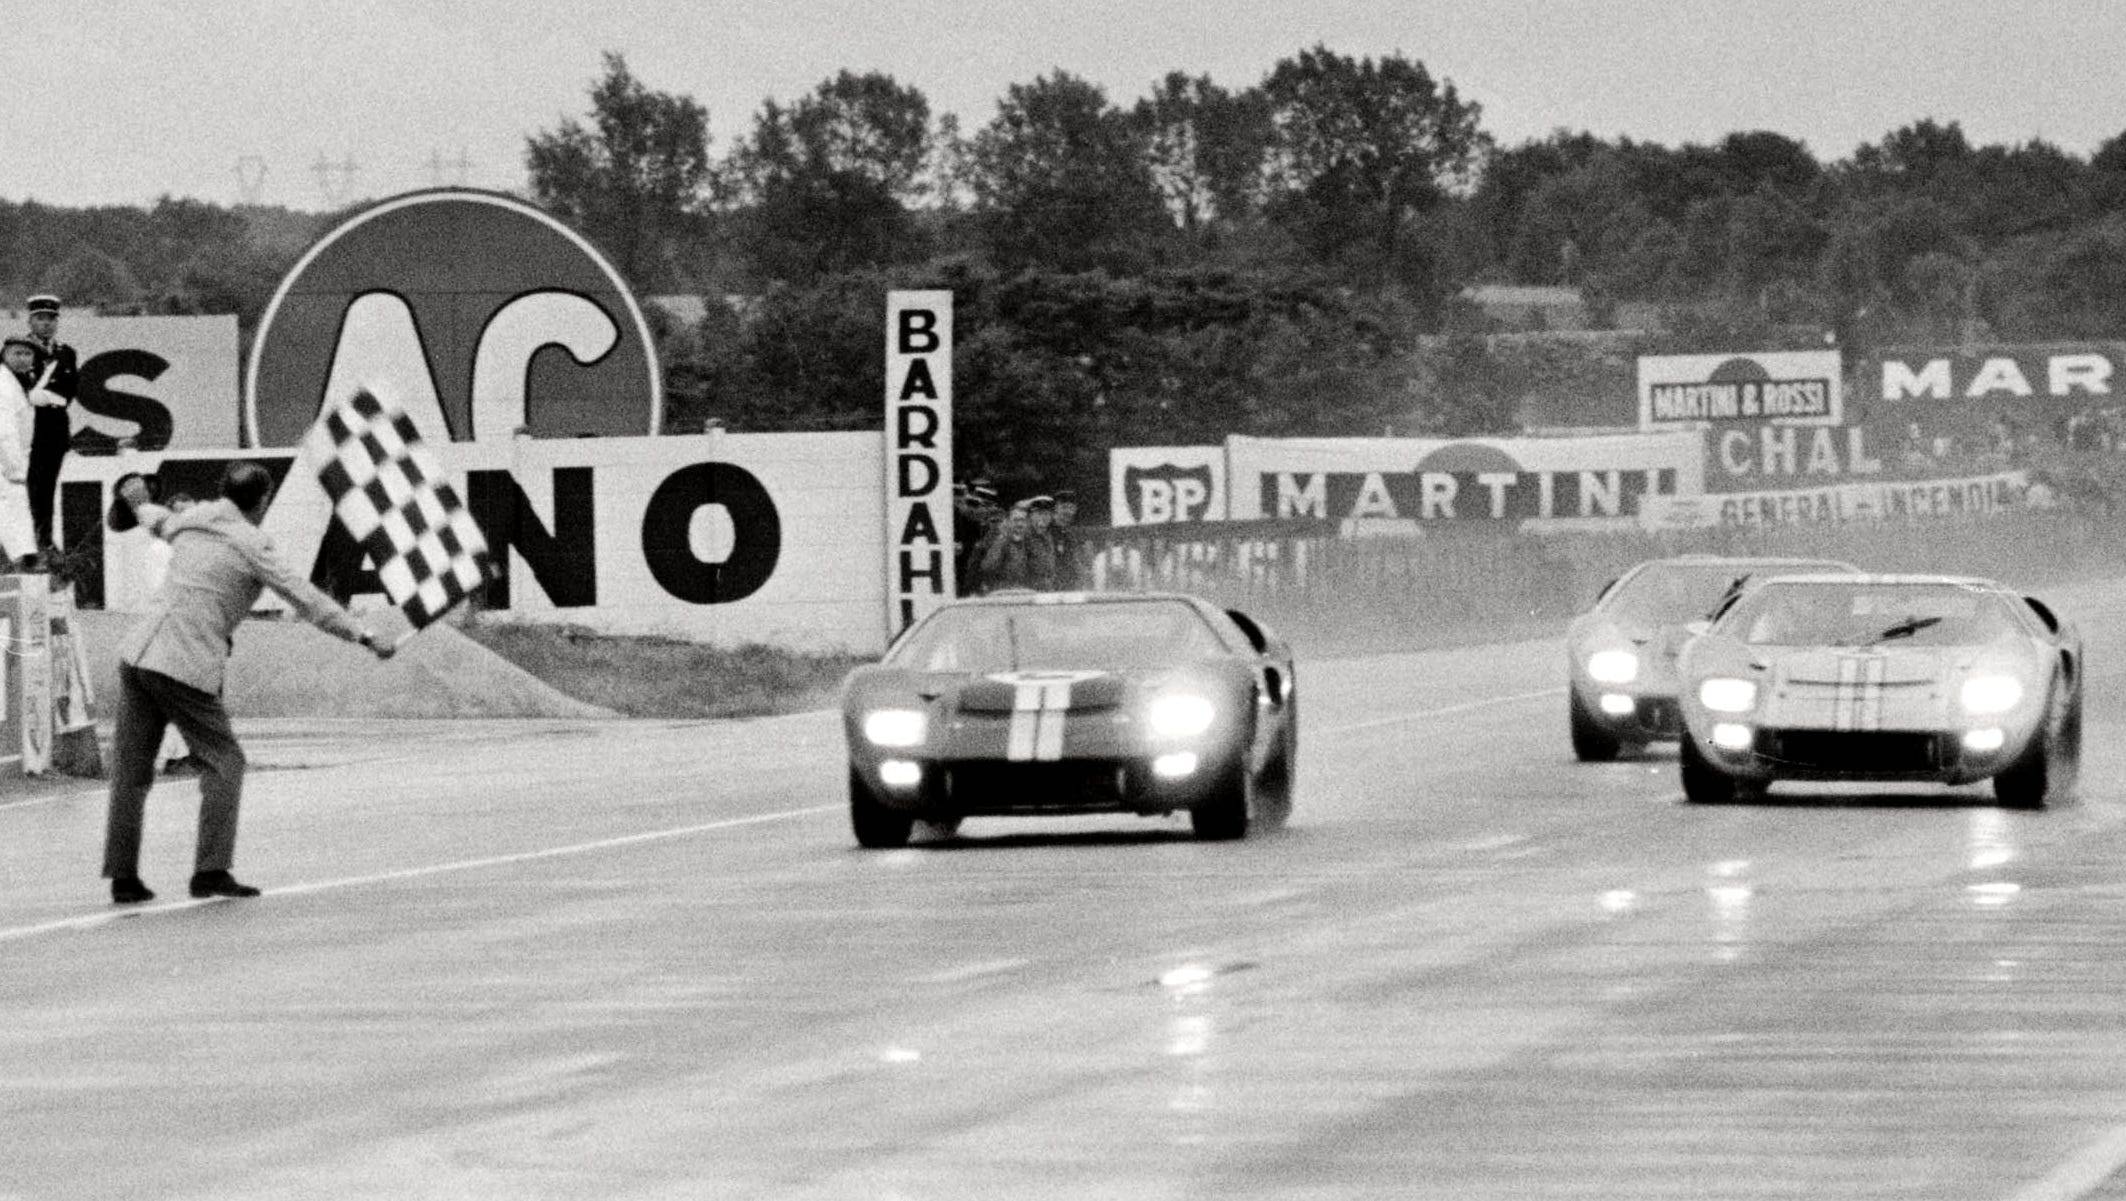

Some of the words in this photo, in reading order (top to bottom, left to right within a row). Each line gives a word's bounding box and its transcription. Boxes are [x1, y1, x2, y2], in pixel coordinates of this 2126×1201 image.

[1882, 354, 2114, 399] MAR
[1654, 384, 1738, 419] MARTINI
[1743, 382, 1760, 417] &
[1763, 380, 1825, 415] ROSSI
[1720, 426, 1881, 475] CHAL
[1139, 478, 1207, 523] BP
[1277, 467, 1661, 519] MARTINI
